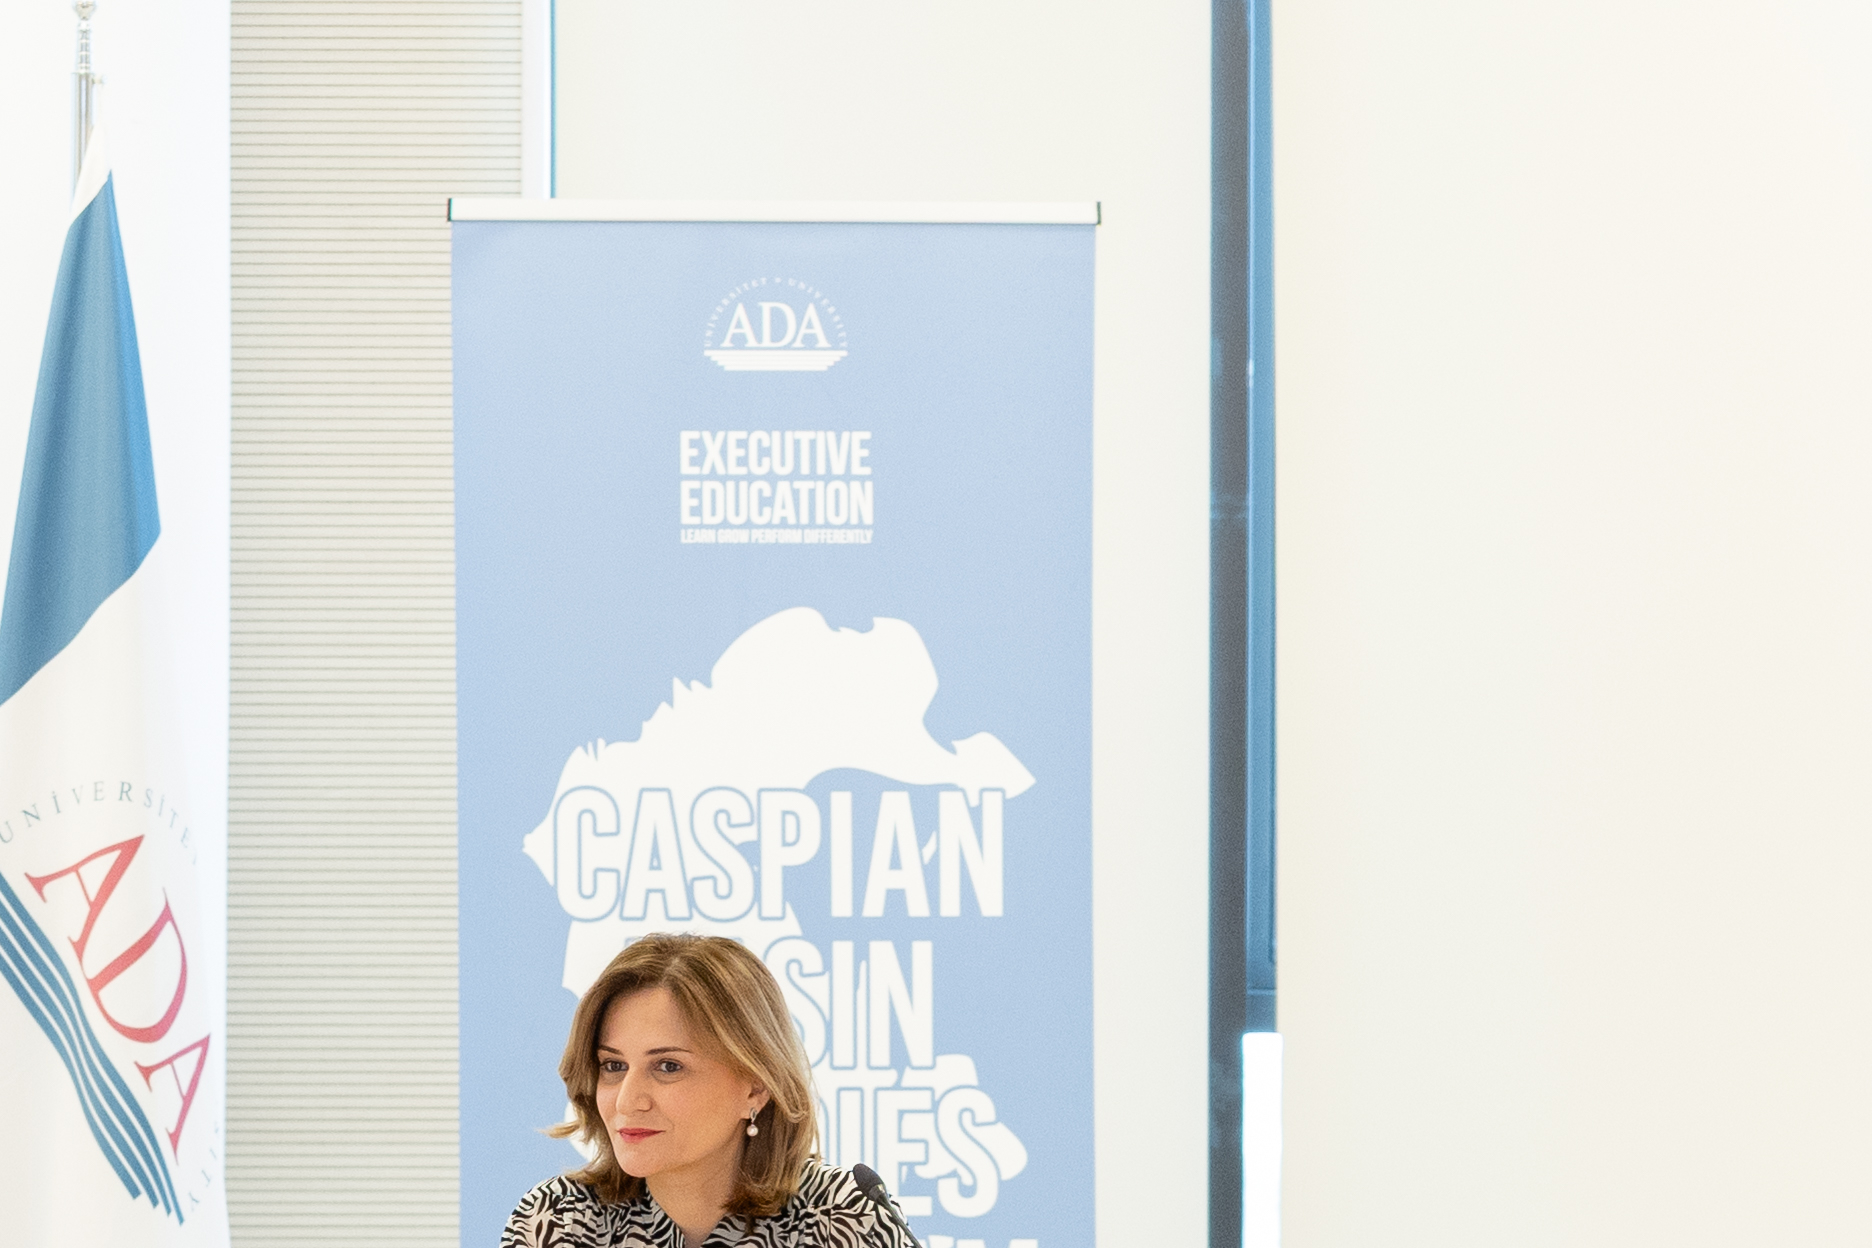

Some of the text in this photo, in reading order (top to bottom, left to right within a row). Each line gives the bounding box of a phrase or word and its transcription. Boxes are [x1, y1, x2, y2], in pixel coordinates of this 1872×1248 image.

[720, 301, 832, 348] ADA
[679, 429, 872, 475] EXECUTIVE
[679, 479, 874, 526] EDUCATION
[680, 528, 874, 544] LEARN GROW PERFORM DIFFERENTLY
[552, 785, 1007, 923] CASPIAN
[24, 833, 212, 1166] ADA
[624, 934, 935, 1071] SIN
